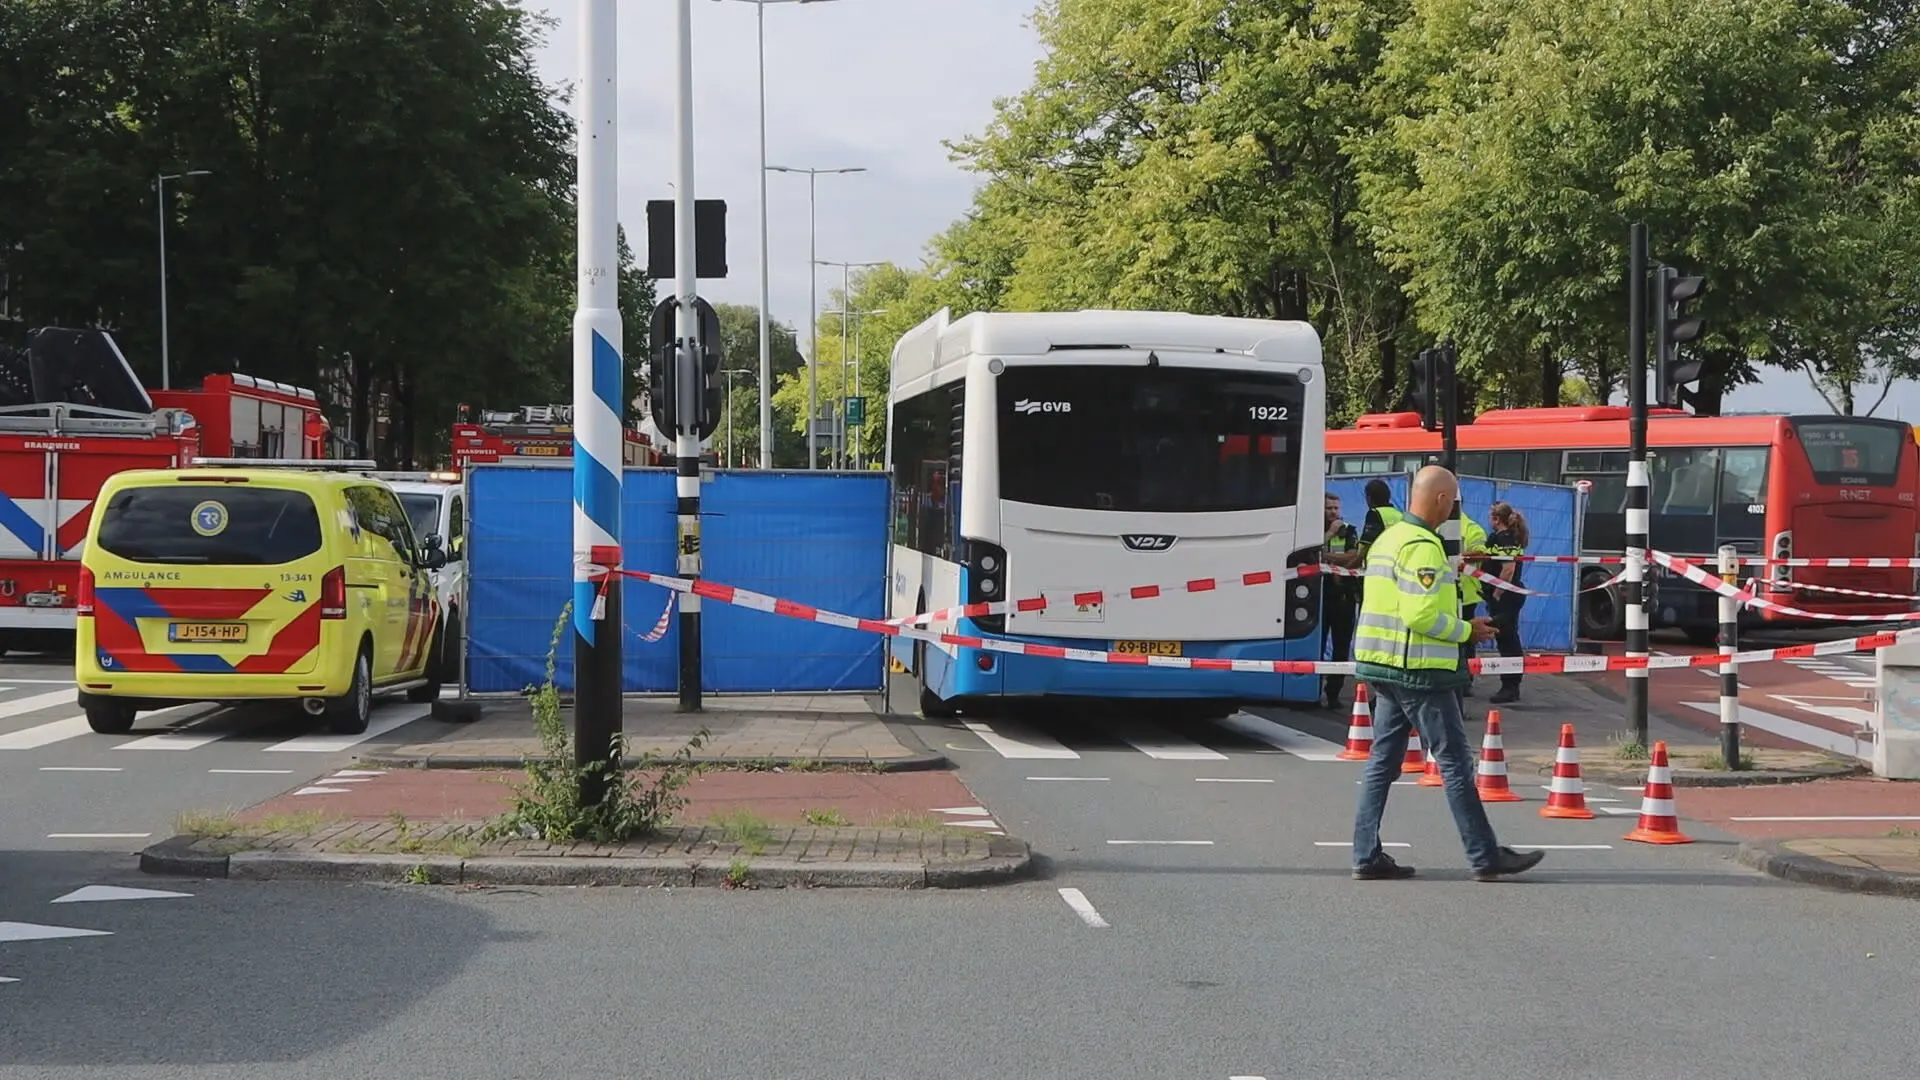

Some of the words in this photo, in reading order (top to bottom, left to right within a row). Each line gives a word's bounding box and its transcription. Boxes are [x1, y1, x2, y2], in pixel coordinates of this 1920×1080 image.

[1042, 401, 1072, 413] GVB
[1249, 406, 1288, 420] 1922
[24, 441, 81, 450] BRANDWEER
[1747, 504, 1765, 514] 4102
[1129, 536, 1167, 548] VDL
[104, 571, 181, 580] AMBULANCE
[280, 573, 312, 582] 13-341
[182, 626, 241, 637] J-154-HP
[1118, 641, 1177, 654] 69-BPL-2
